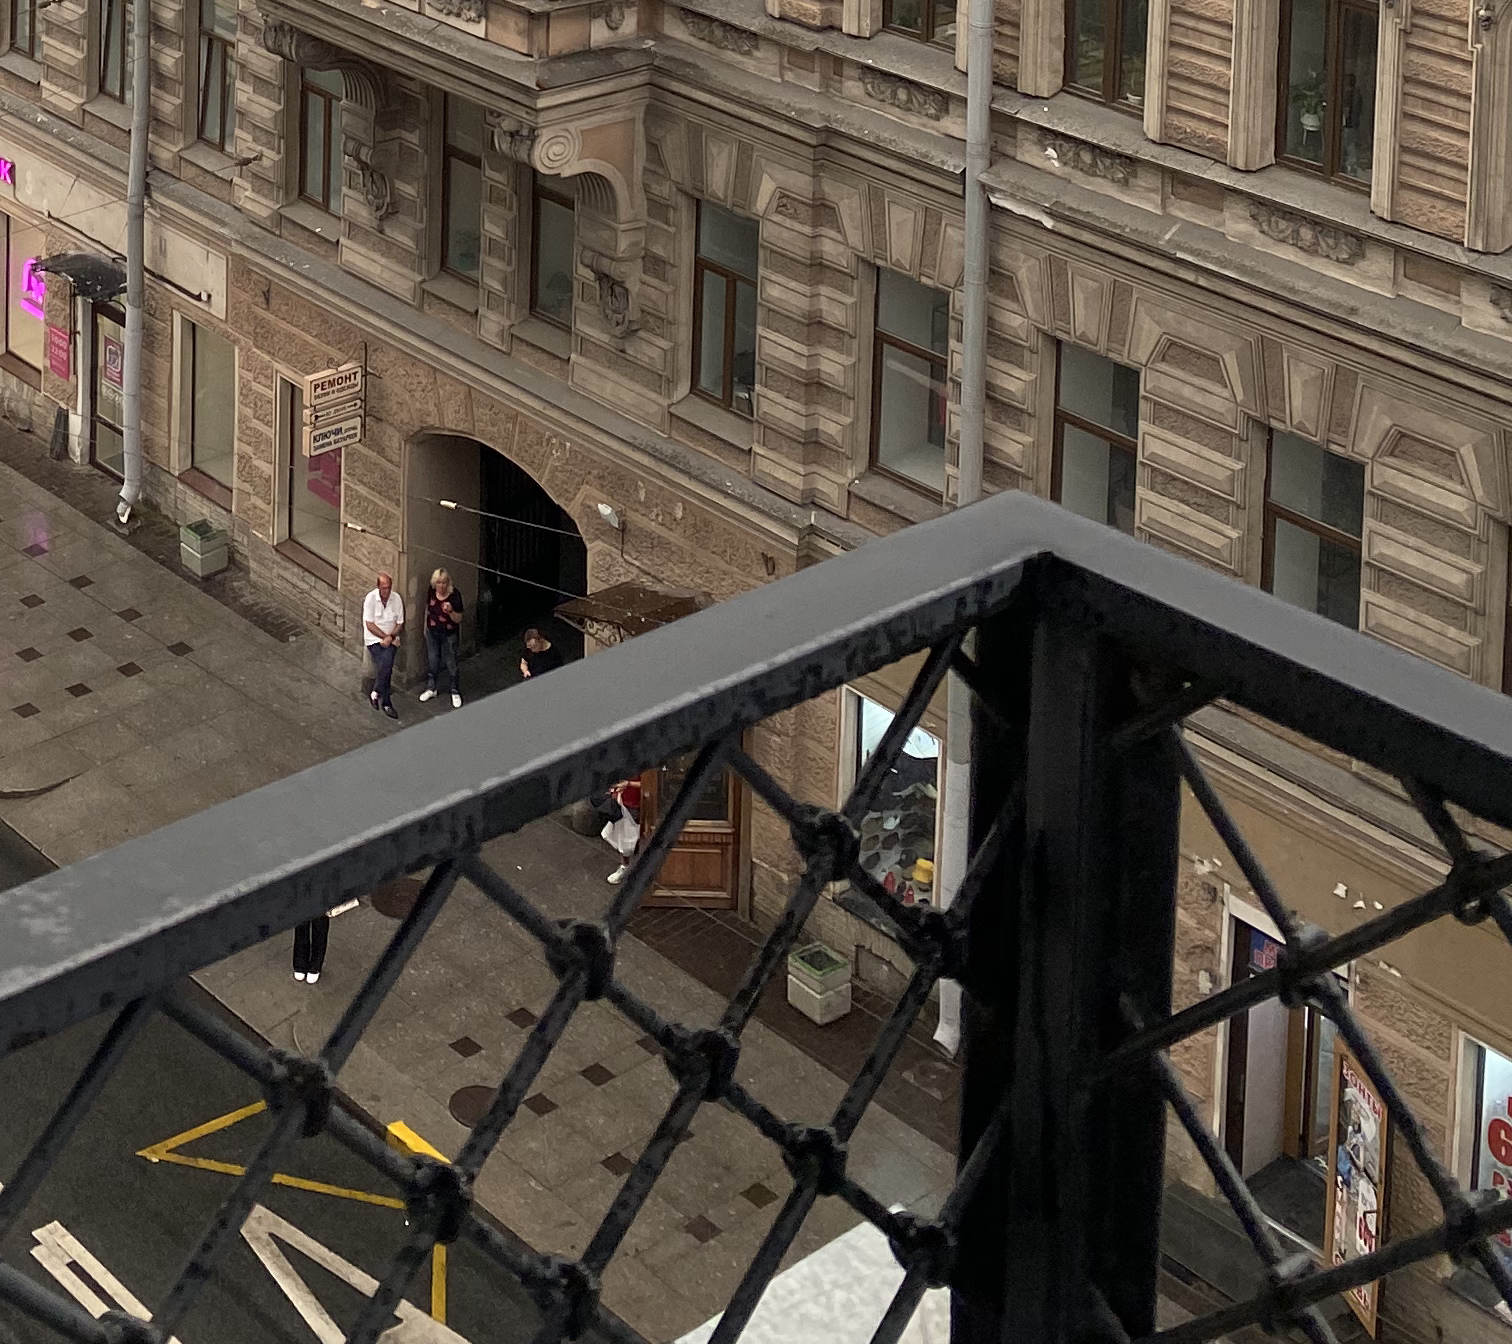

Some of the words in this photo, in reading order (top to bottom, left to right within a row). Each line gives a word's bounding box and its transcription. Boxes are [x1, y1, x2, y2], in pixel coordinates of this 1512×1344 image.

[313, 371, 359, 394] РЕМОНТ
[313, 426, 343, 444] КЛЮЧИ
[1343, 1061, 1383, 1121] ЗОНТЫ
